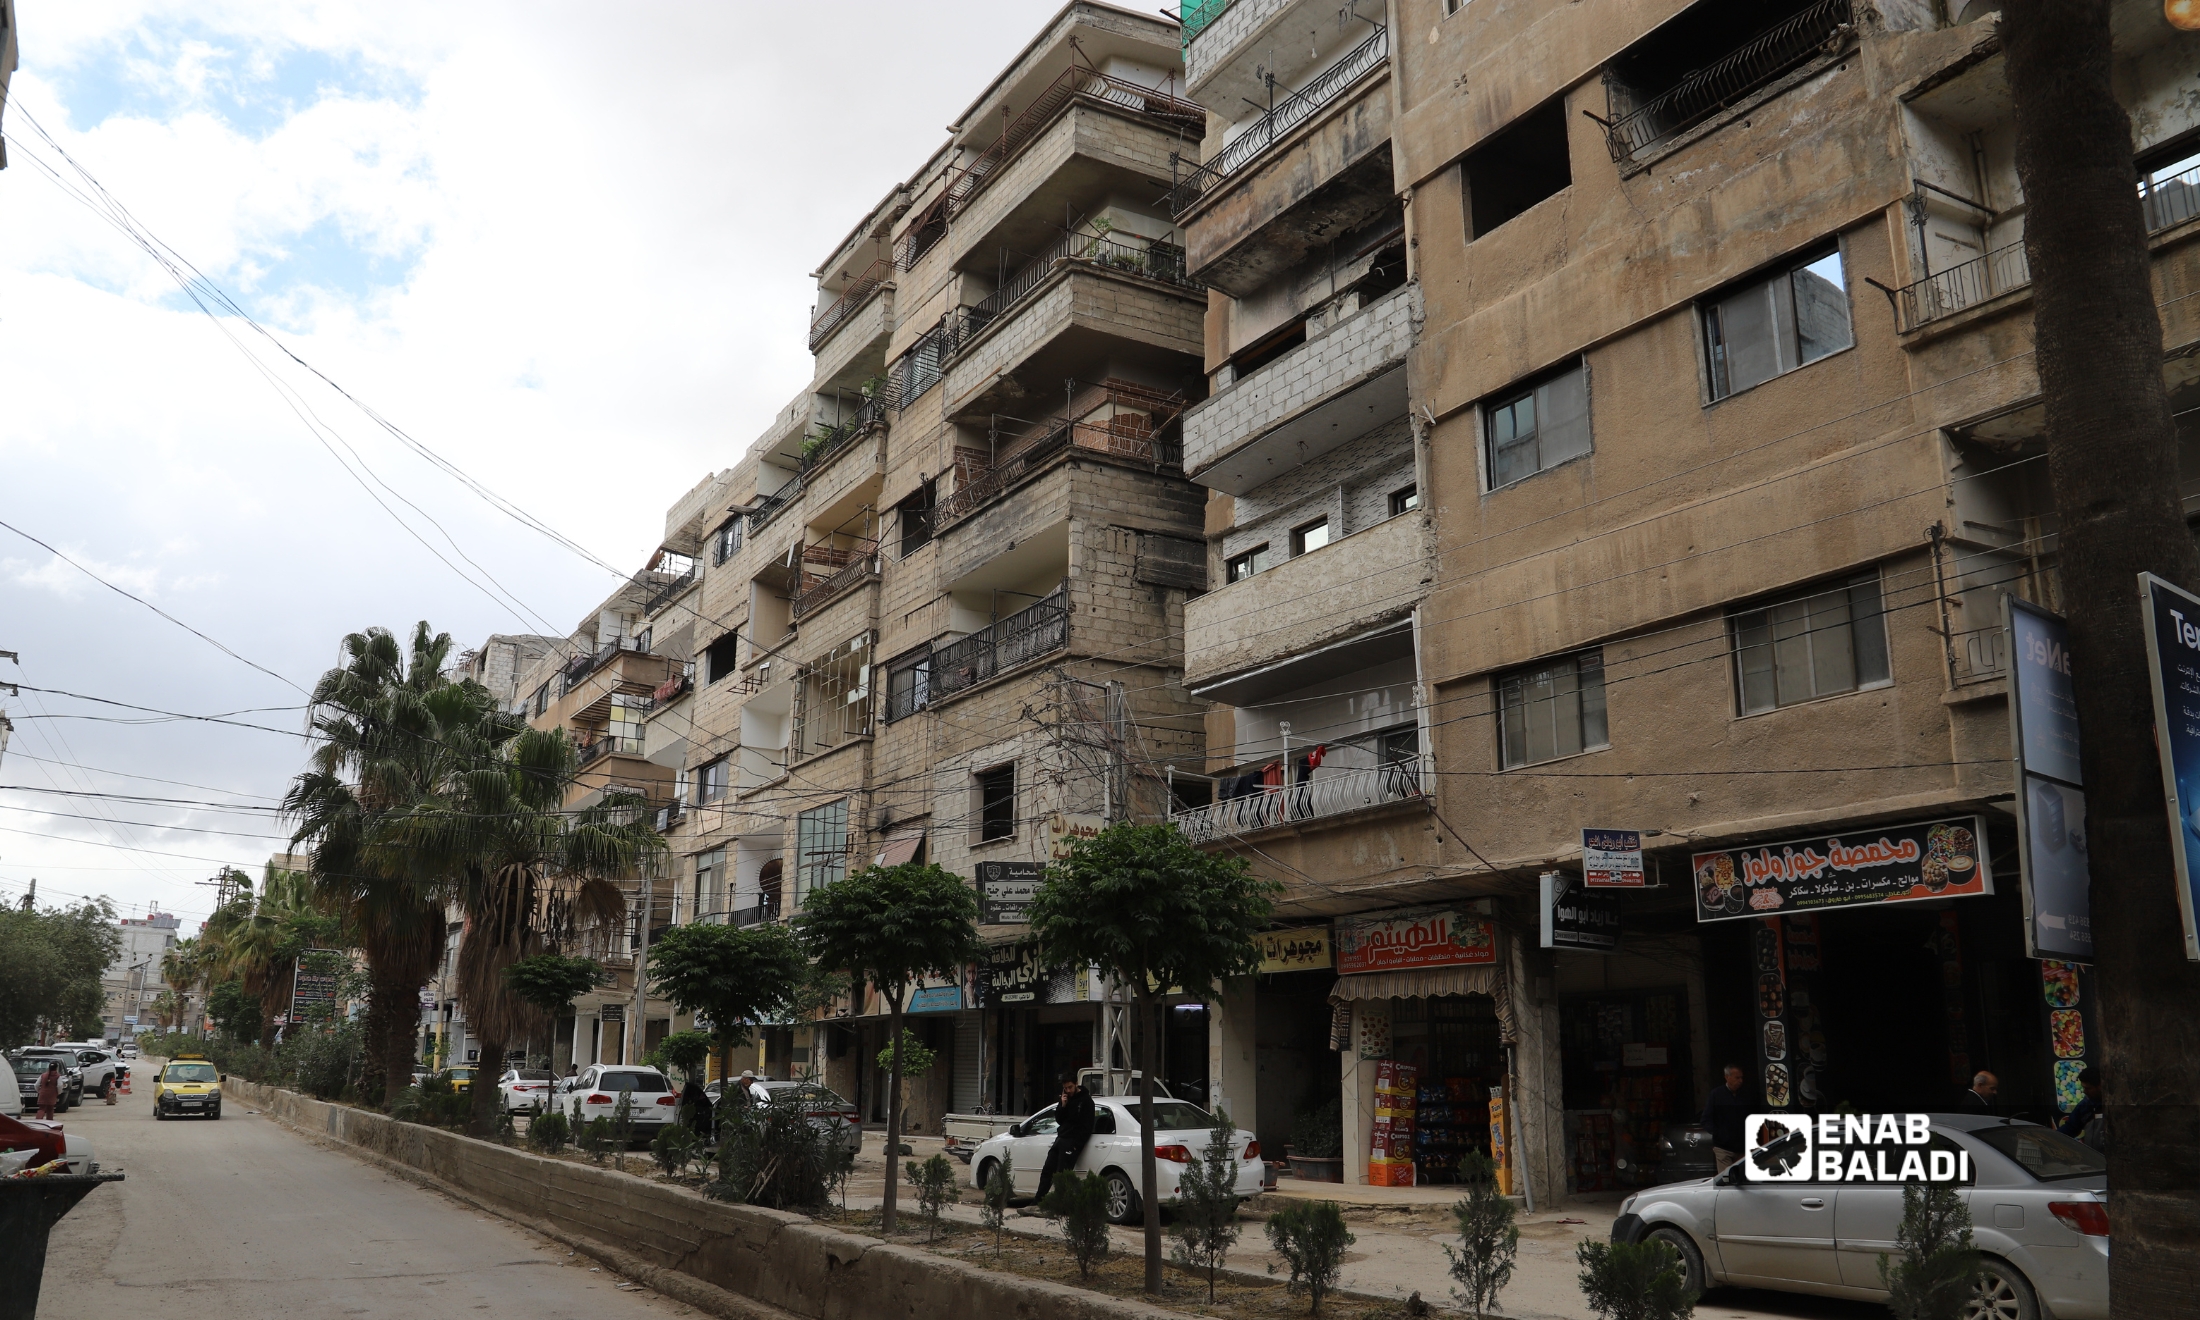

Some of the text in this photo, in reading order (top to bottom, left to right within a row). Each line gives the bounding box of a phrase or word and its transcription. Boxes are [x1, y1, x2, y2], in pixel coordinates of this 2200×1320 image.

[1740, 837, 1922, 887] محمصة جوز ولوز
[1008, 867, 1039, 878] محامية
[1001, 885, 1013, 898] علي
[1015, 886, 1030, 894] محمد
[1788, 875, 1919, 899] موالح مكسرات بن شوكولا سكاكر
[1557, 904, 1577, 922] الهوا
[1266, 936, 1324, 965] مجوهرات
